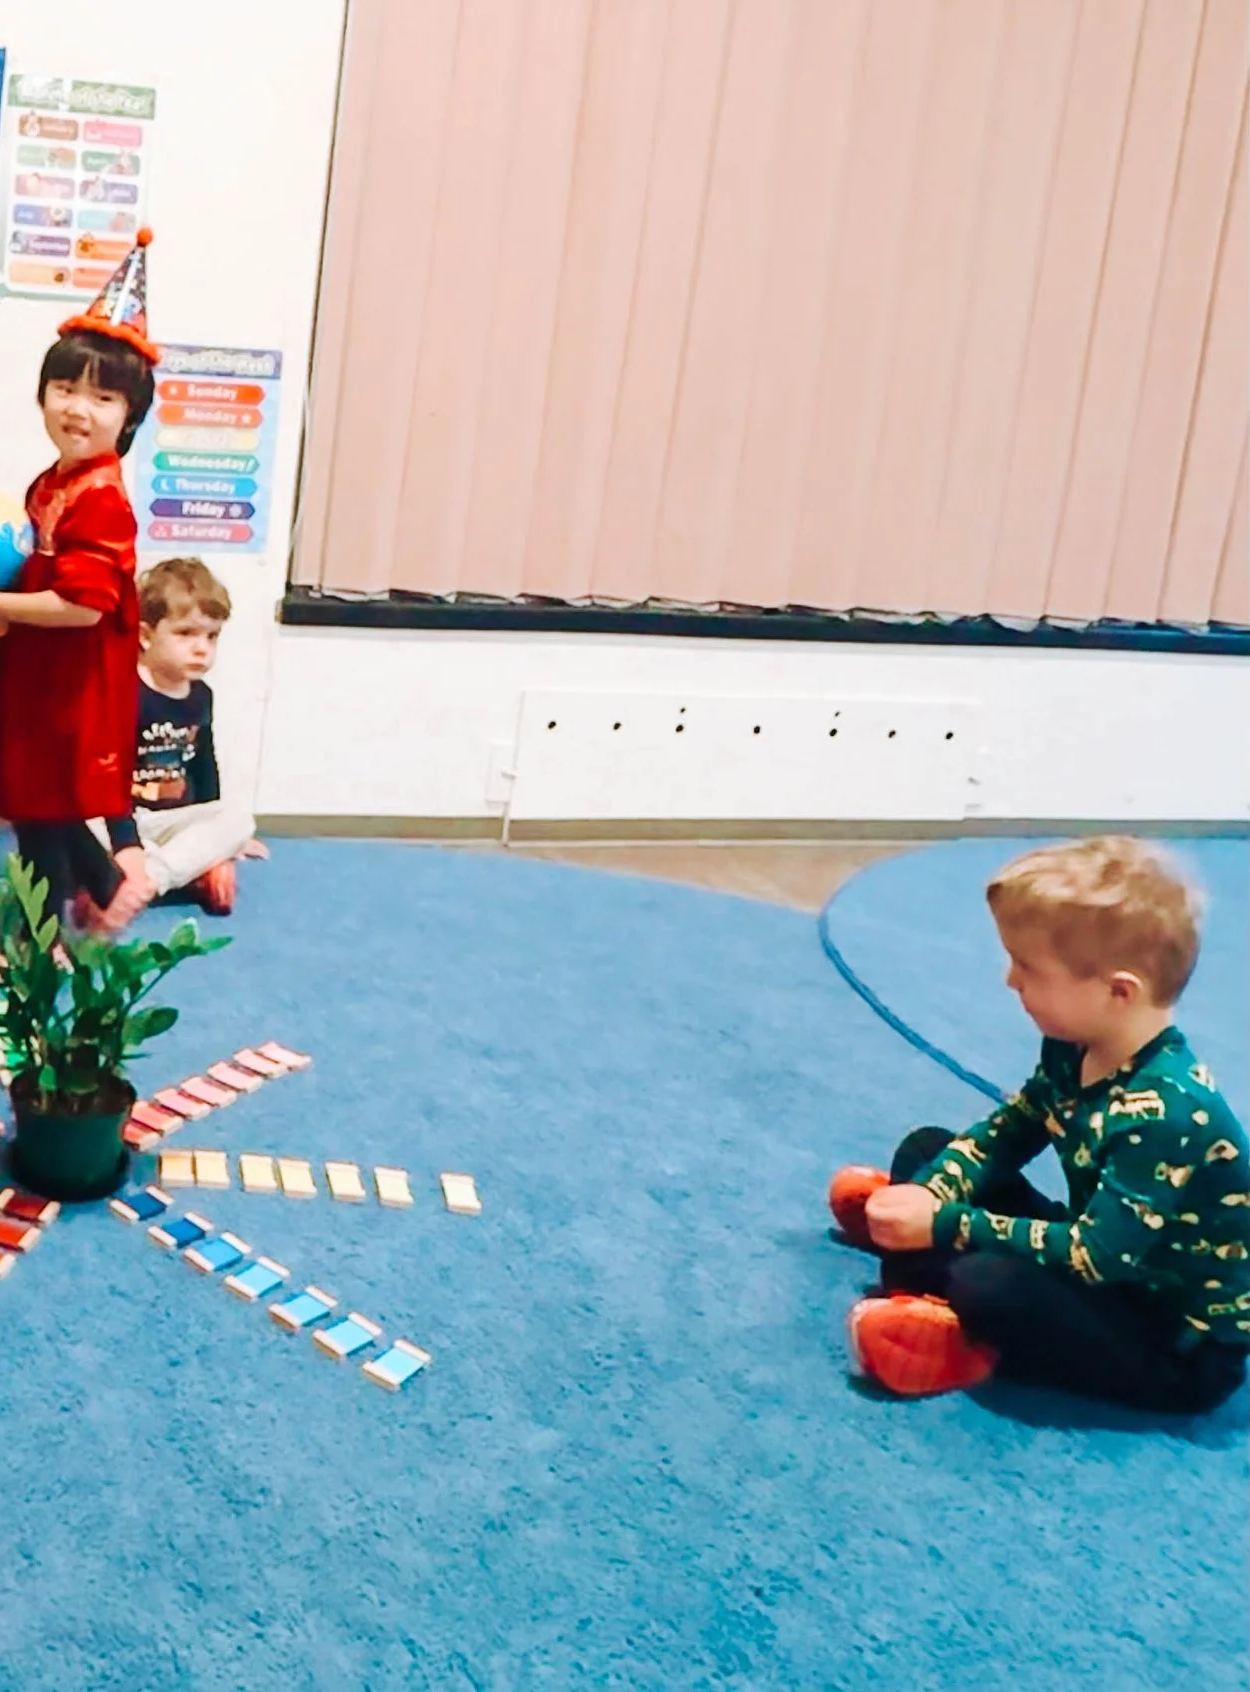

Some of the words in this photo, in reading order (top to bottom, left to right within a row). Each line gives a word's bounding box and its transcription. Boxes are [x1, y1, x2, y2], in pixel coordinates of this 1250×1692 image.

[187, 384, 239, 401] Sunday
[167, 455, 248, 473] Wednesday
[175, 478, 236, 495] Thursday
[182, 502, 226, 519] Friday
[171, 525, 233, 540] Saturday
